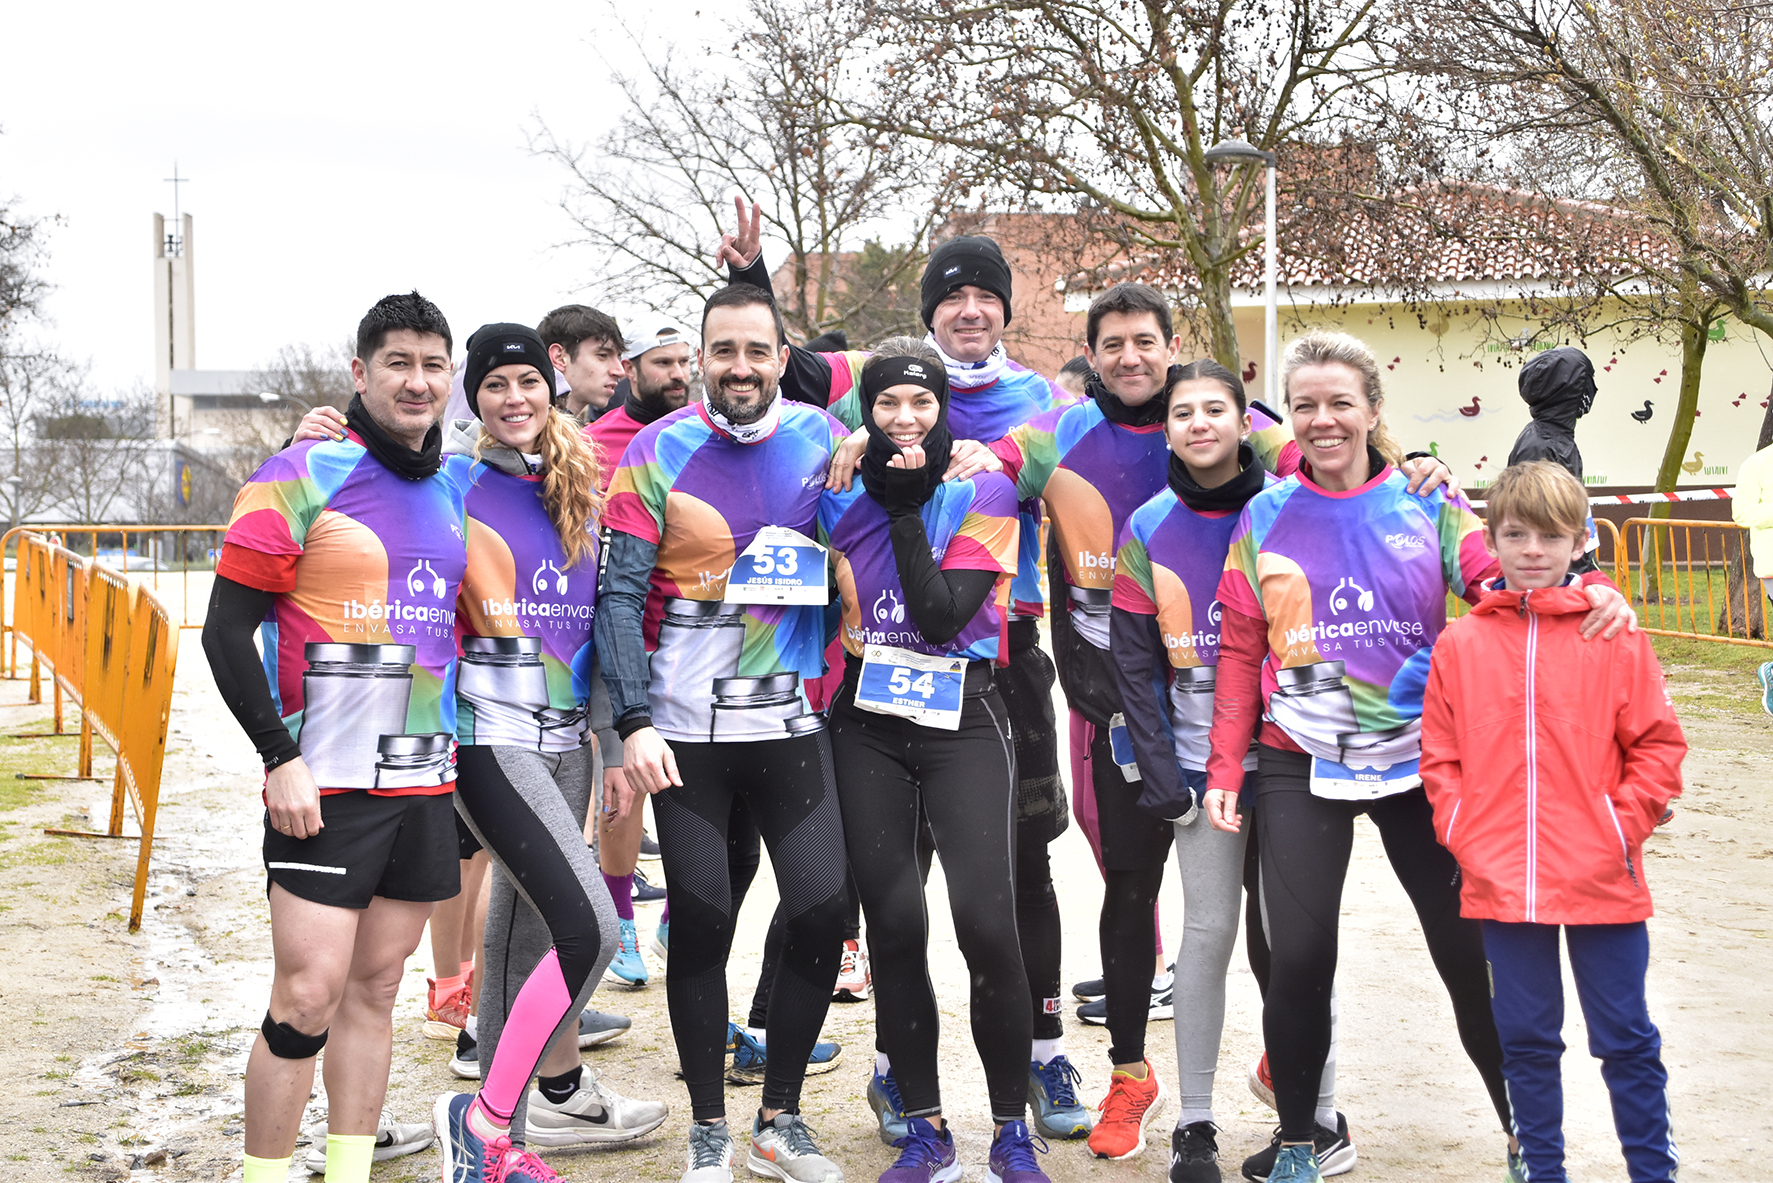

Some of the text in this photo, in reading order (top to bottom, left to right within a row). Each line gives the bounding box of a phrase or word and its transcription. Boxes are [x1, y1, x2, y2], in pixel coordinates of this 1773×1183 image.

[752, 547, 798, 576] 53
[747, 576, 803, 586] JESÚS ISIDRO
[482, 597, 595, 619] Ibéricaenvas
[343, 623, 449, 638] ENVASA TUS
[485, 620, 541, 629] ENVASA
[549, 621, 571, 630] TUS
[1354, 637, 1386, 648] TUS
[888, 667, 935, 699] 54
[892, 697, 926, 708] ESTHER
[1355, 773, 1382, 781] IRENE
